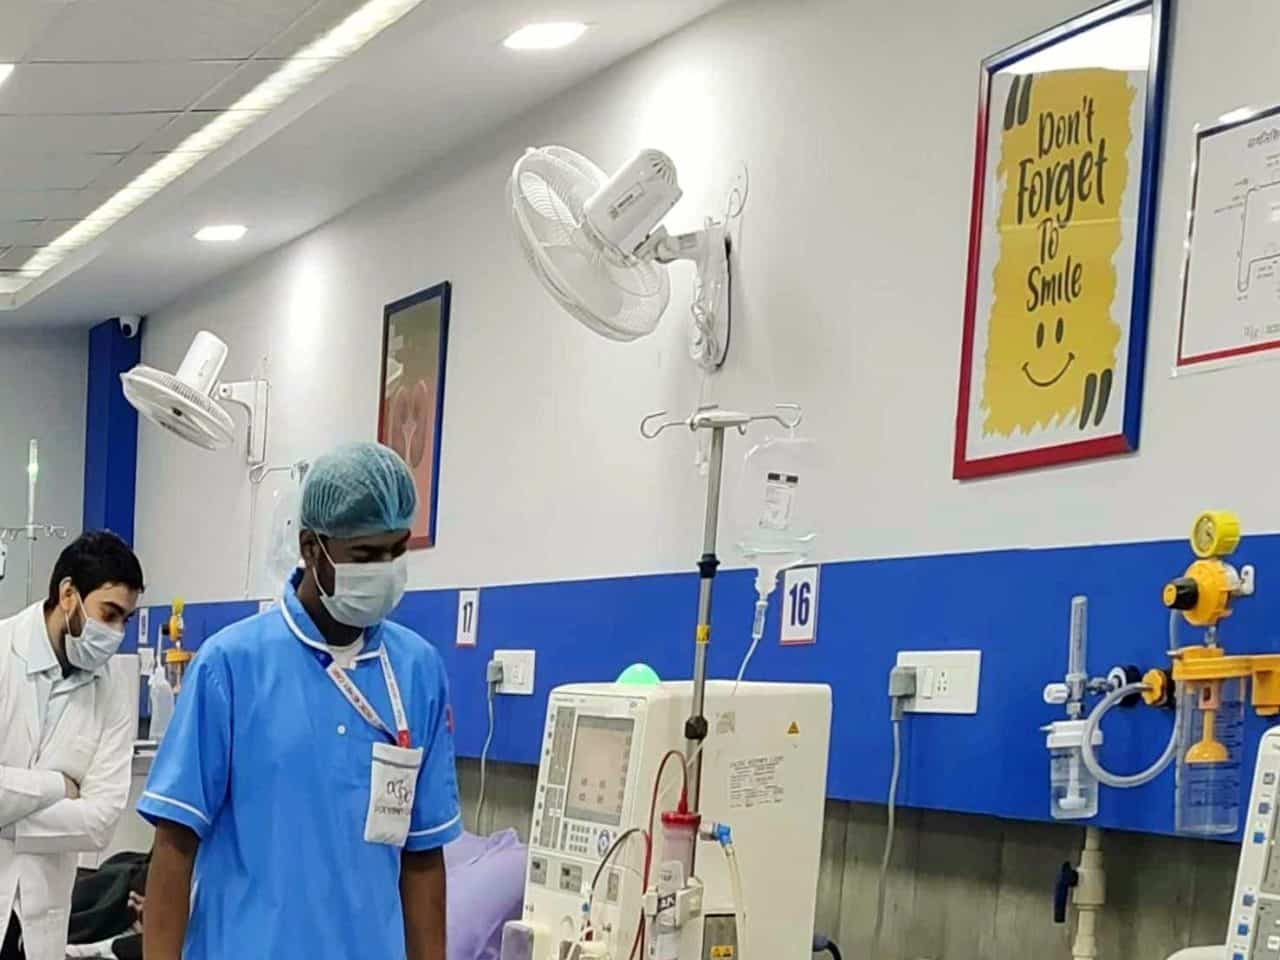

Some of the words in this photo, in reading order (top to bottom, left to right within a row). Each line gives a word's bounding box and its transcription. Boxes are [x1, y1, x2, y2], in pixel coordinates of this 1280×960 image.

[1038, 95, 1095, 159] Don't
[1018, 138, 1108, 229] Forget
[1038, 217, 1059, 264] To
[1026, 255, 1082, 312] Smile
[463, 601, 473, 633] 17
[789, 582, 811, 627] 16
